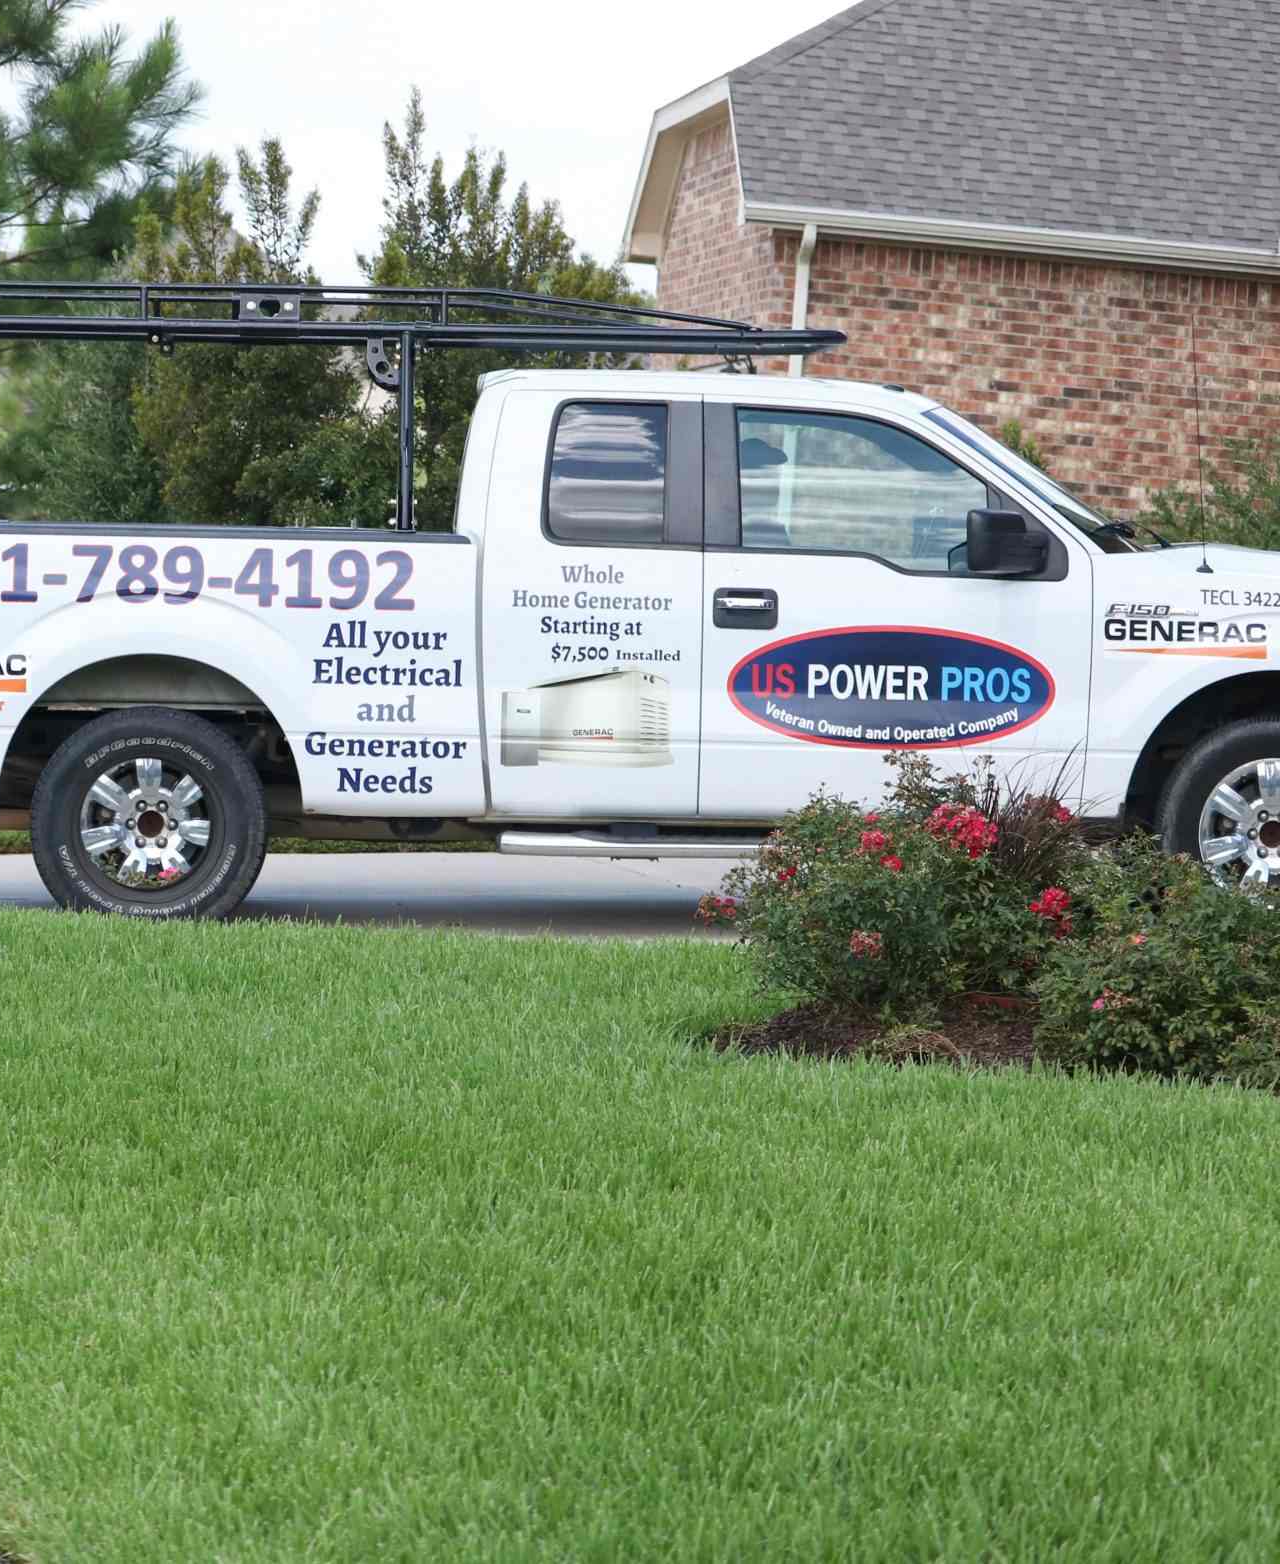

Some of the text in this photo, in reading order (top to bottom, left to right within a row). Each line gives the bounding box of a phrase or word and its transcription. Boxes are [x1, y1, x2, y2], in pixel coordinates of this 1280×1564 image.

[561, 564, 624, 584] Whole
[512, 590, 673, 611] Home Generator
[1200, 589, 1239, 606] TECL
[322, 620, 447, 657] All your
[540, 615, 643, 641] Starting at
[1104, 618, 1267, 642] GENERAC
[551, 641, 681, 663] $7,500 Installed
[311, 656, 463, 688] Electrical
[751, 663, 1032, 704] US POWER PROS
[356, 693, 416, 722] and
[572, 728, 614, 737] GENERAC
[765, 700, 1020, 744] Veteran Owned and Operated Company
[304, 731, 468, 760] Generator
[336, 765, 434, 795] Needs
